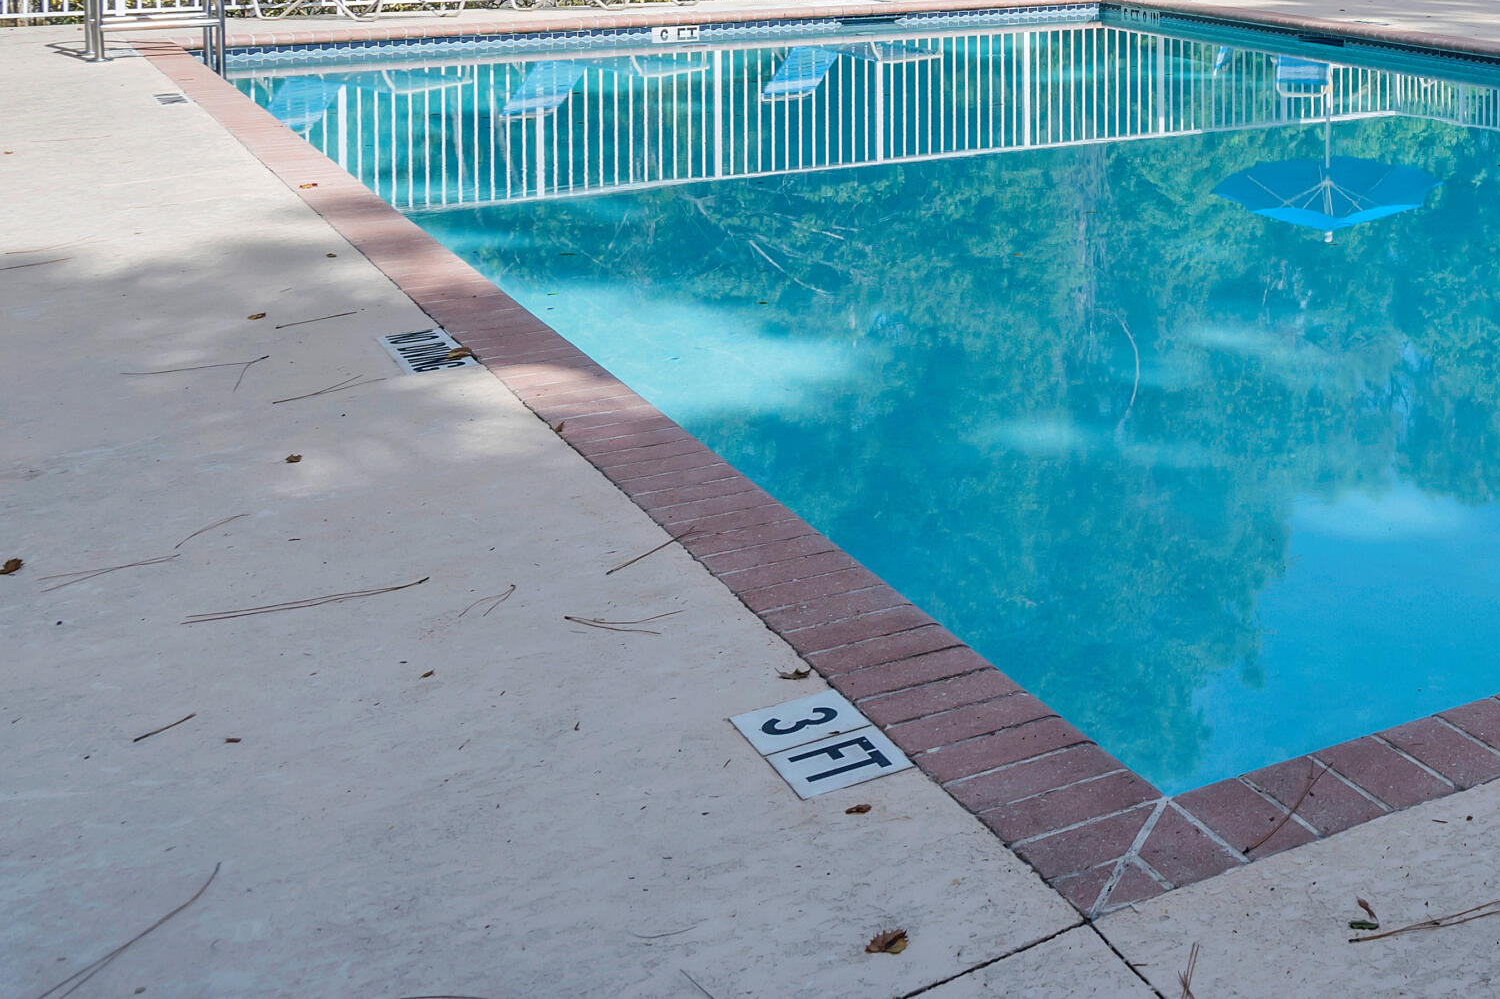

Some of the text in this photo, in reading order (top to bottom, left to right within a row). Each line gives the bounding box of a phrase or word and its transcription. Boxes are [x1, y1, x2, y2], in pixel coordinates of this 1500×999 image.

[385, 329, 467, 373] NO DIVING
[761, 706, 893, 783] 3 FT
